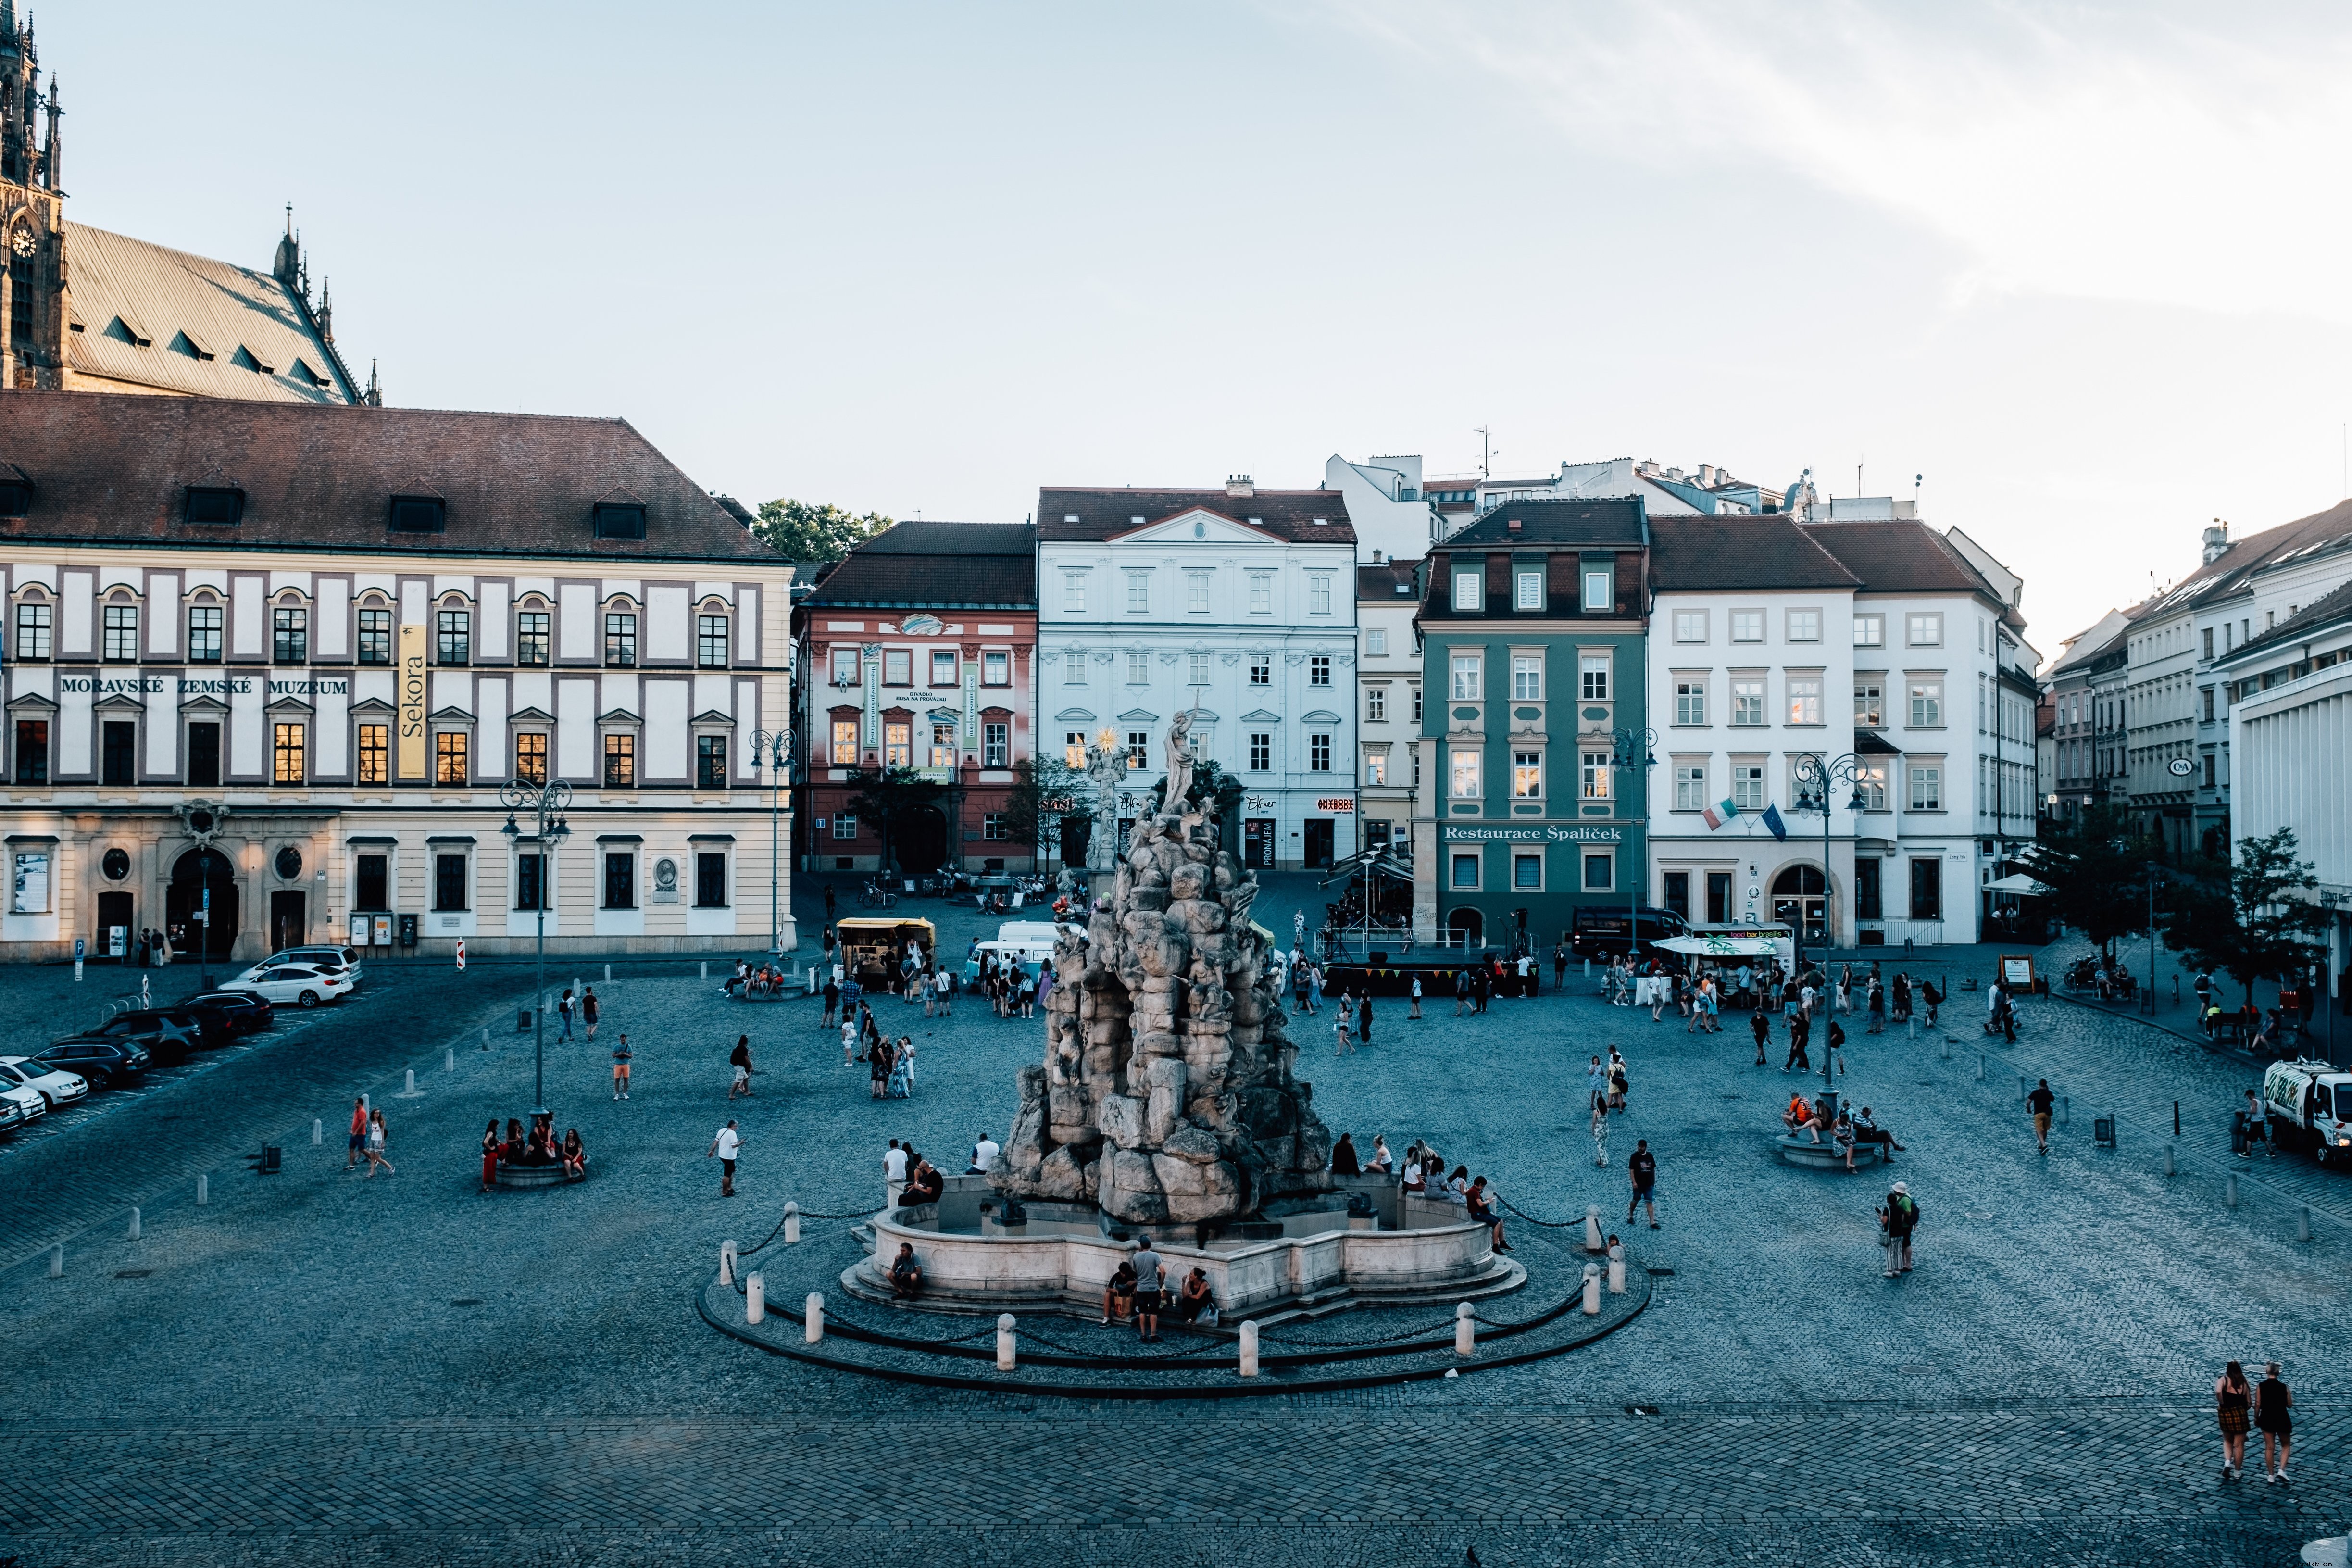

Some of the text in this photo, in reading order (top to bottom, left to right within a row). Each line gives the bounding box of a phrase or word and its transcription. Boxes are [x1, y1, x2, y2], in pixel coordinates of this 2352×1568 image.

[61, 676, 347, 694] MORAVSKÉ ZEMSKÉ MUZEUM
[401, 656, 423, 737] Sekora
[2173, 763, 2189, 771] C&A
[1444, 825, 1622, 841] Restaurace Špalíček
[1263, 823, 1272, 865] PRONÁJEM
